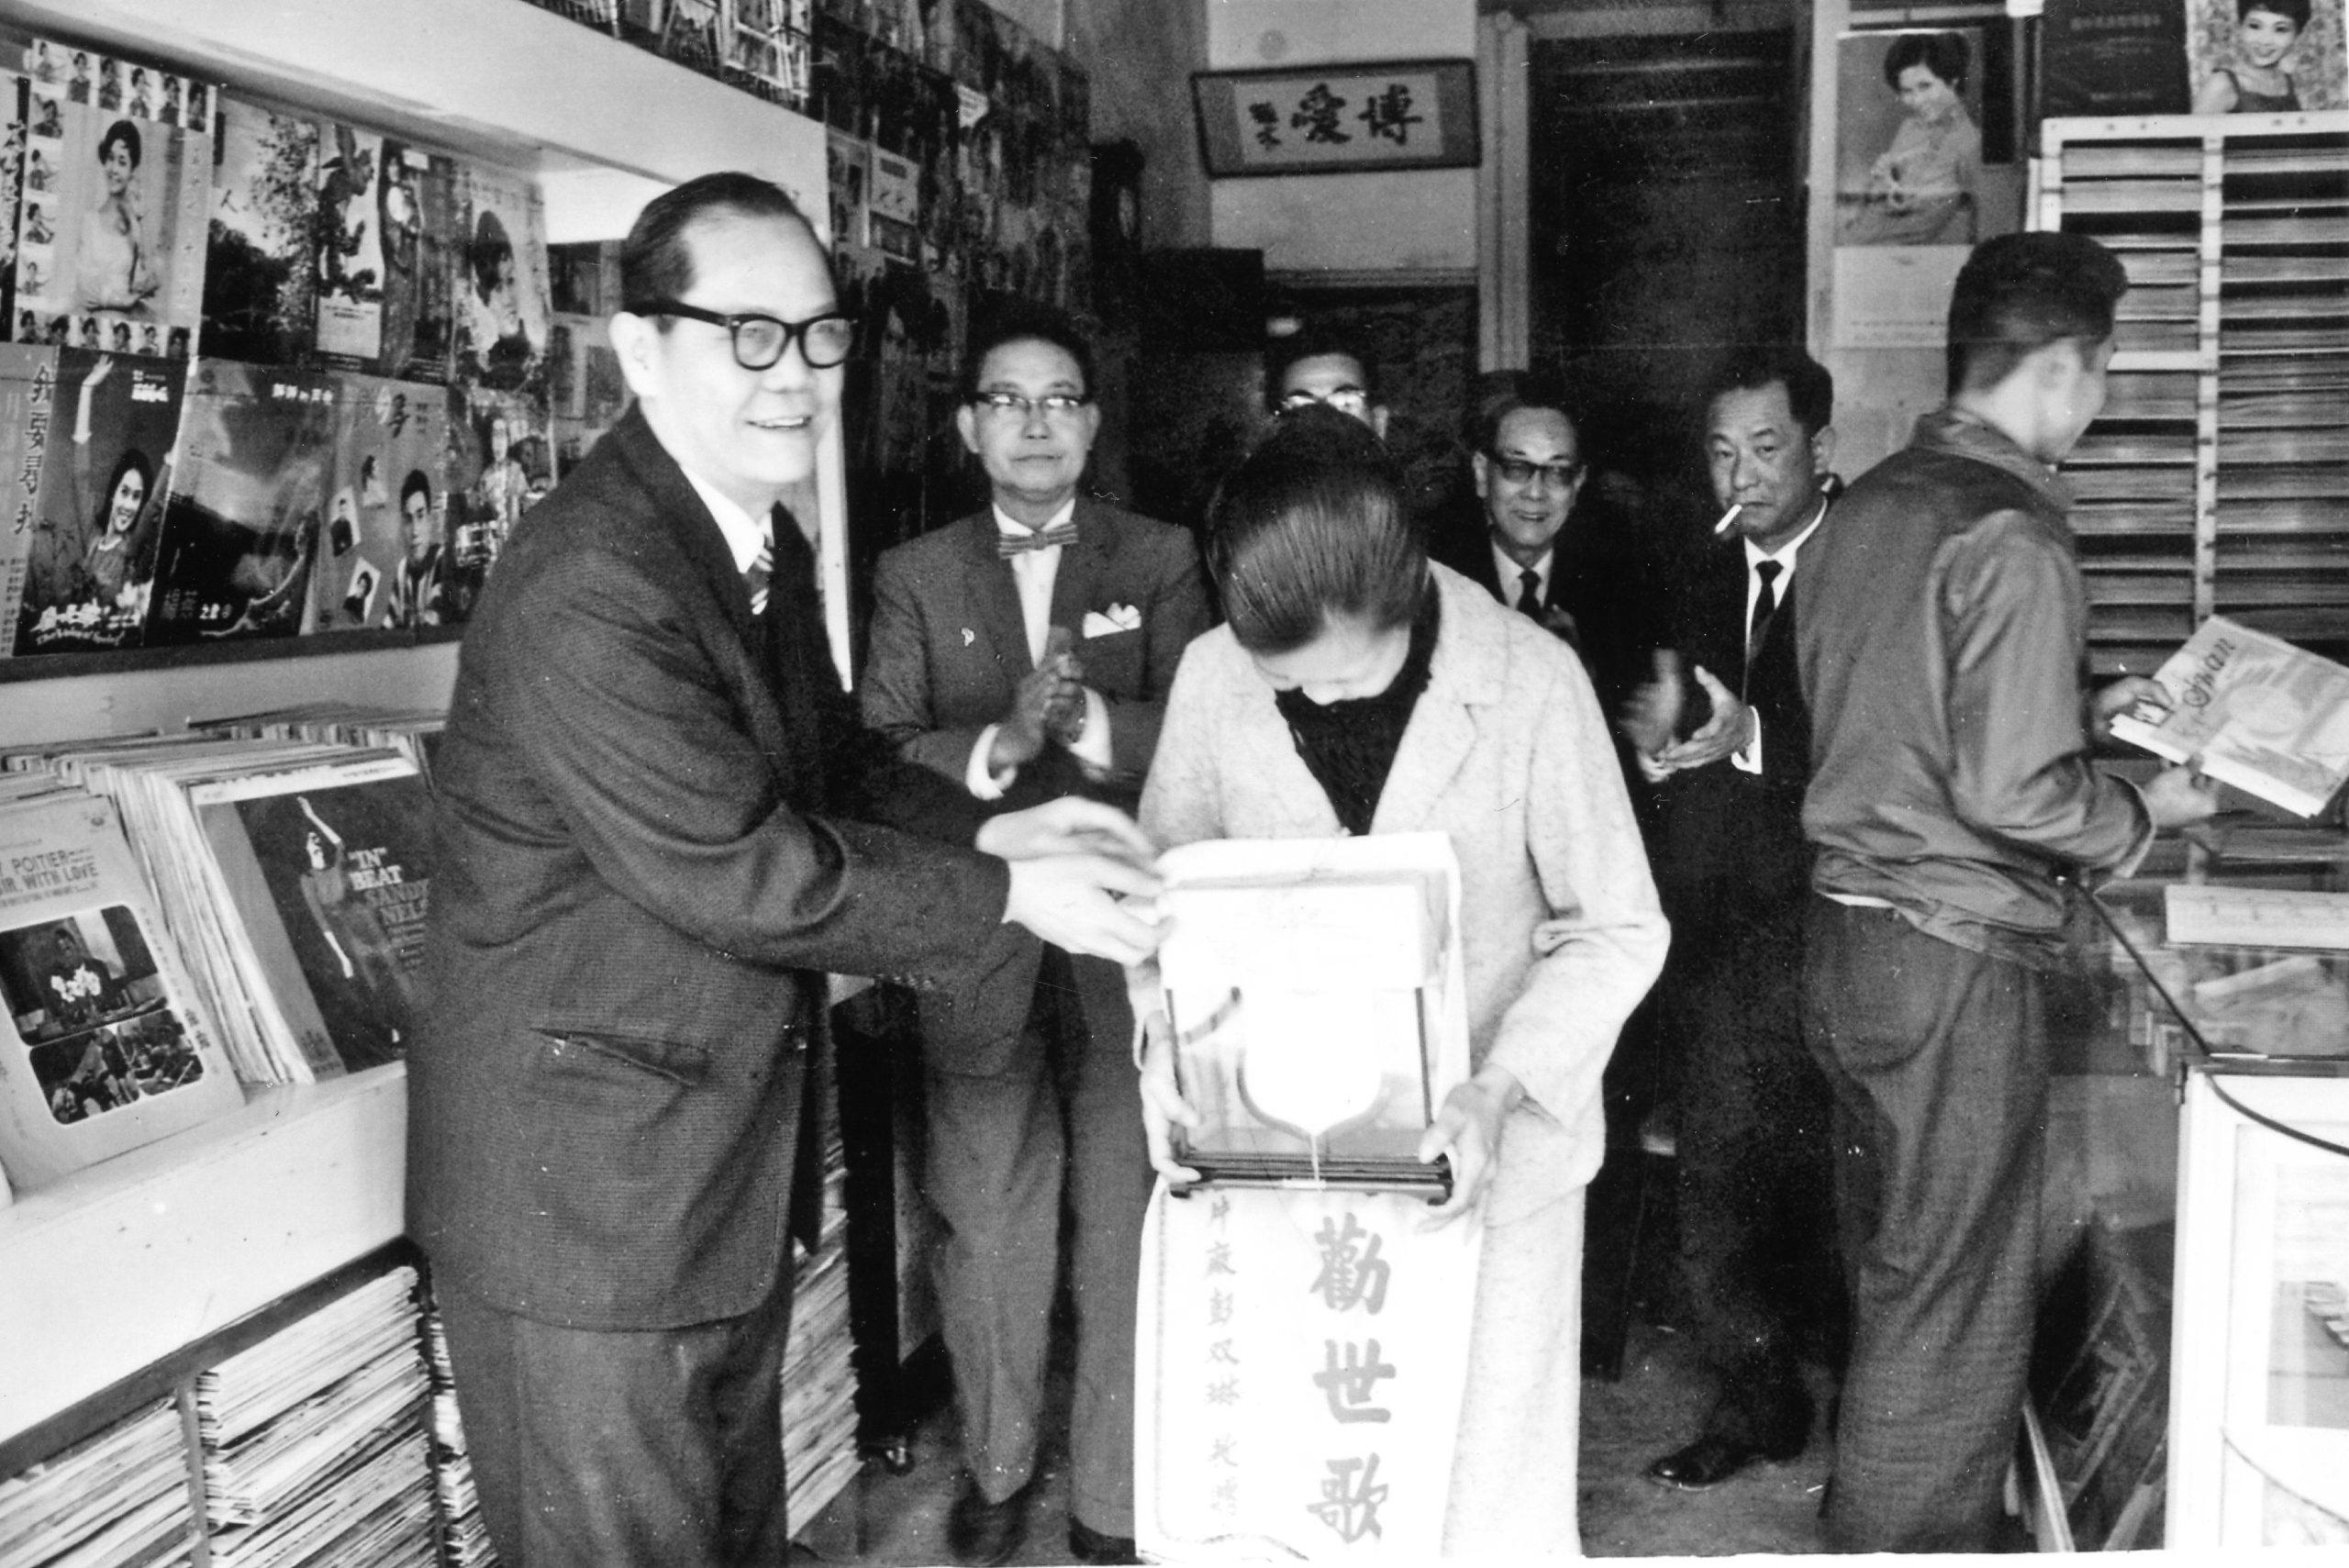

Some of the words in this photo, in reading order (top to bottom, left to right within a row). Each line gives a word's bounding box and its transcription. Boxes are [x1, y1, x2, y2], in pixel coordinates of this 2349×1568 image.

[11, 850, 69, 874] POITIER
[22, 869, 61, 889] WITH
[63, 862, 99, 882] LOVE
[349, 864, 403, 891] BEAT
[364, 878, 430, 907] SANDY
[1306, 1211, 1397, 1545] 勸世歌
